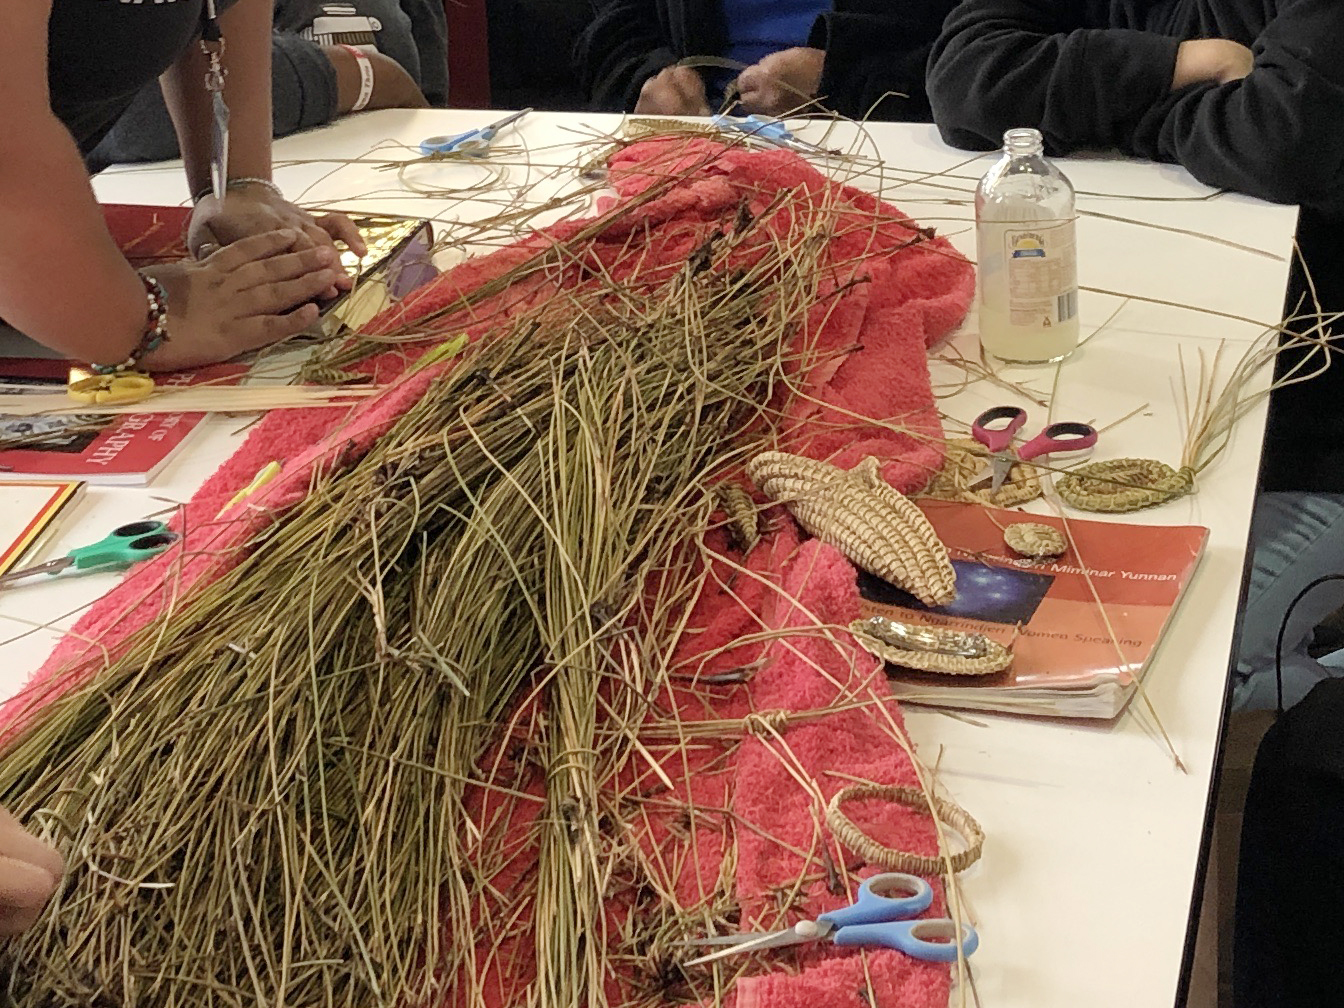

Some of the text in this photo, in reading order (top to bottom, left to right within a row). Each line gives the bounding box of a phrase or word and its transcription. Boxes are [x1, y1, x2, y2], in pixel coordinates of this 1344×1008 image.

[1051, 563, 1116, 578] Miminar
[1120, 570, 1177, 581] Yunnan
[900, 611, 915, 620] to
[920, 613, 1006, 635] Ngarrindjeri
